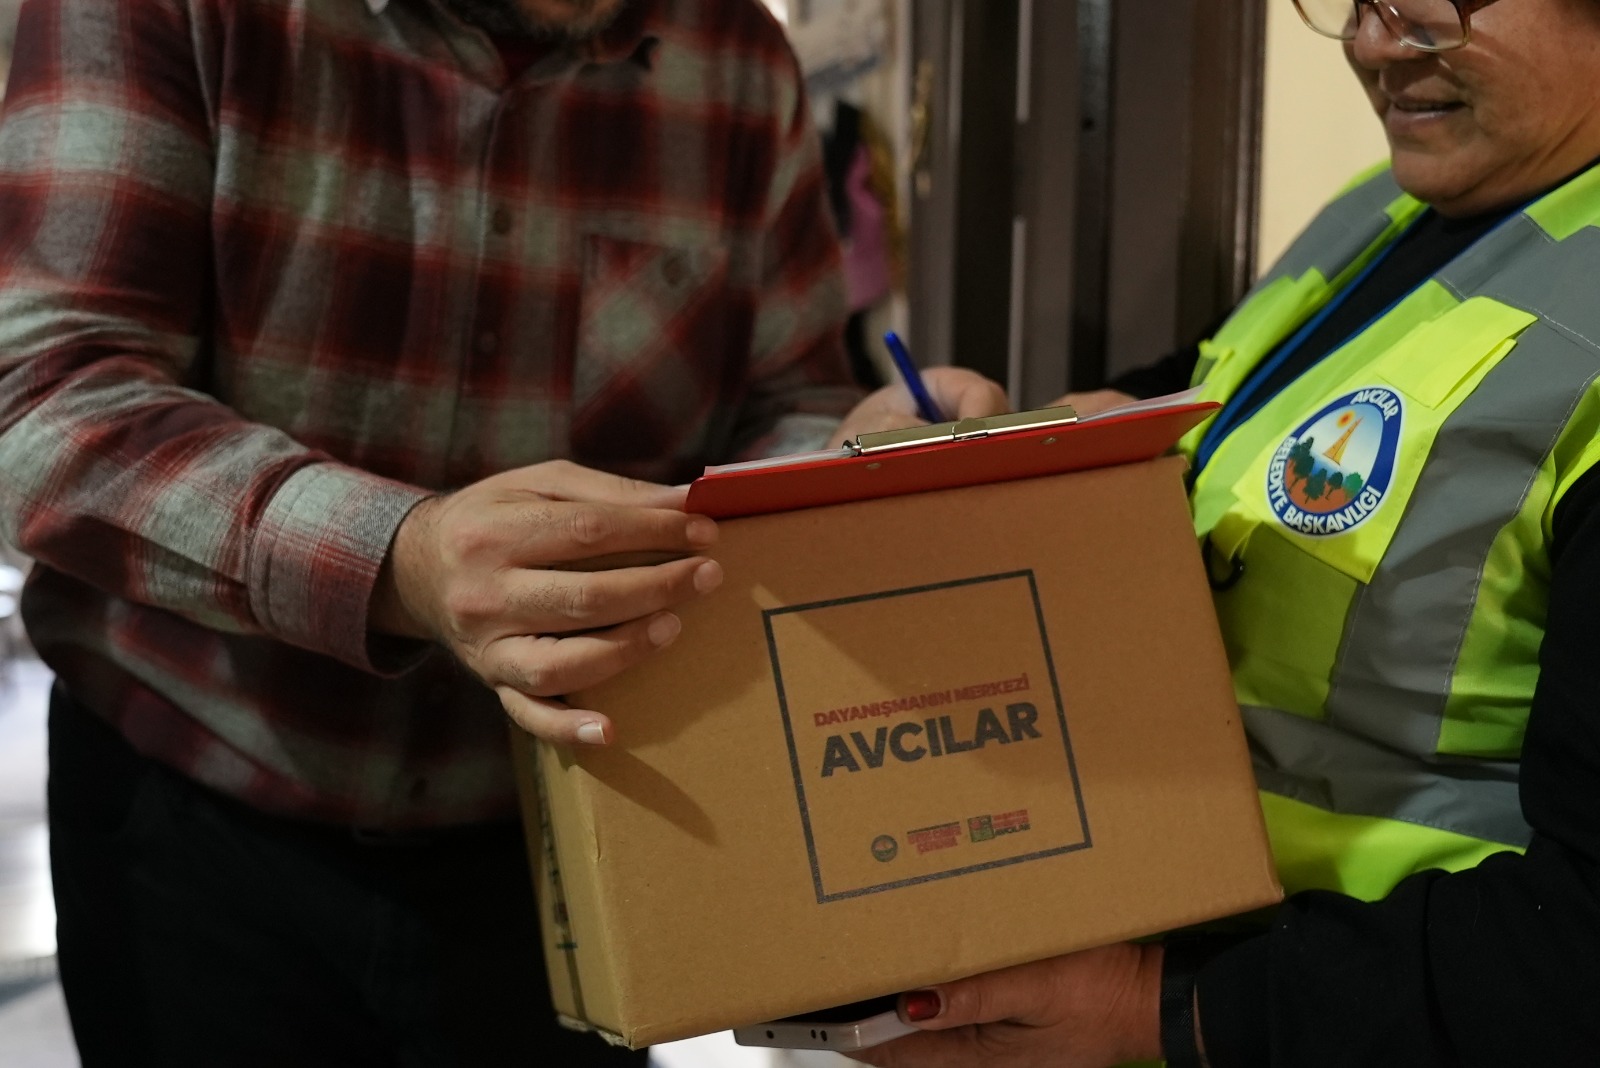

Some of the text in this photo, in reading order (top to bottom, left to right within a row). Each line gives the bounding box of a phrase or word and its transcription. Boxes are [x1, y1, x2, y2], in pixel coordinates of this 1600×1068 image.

[1350, 389, 1399, 421] AVCILAR
[813, 672, 1030, 728] DAYANIŞMANIN MERKEZİ
[821, 702, 1042, 778] AVCILAR
